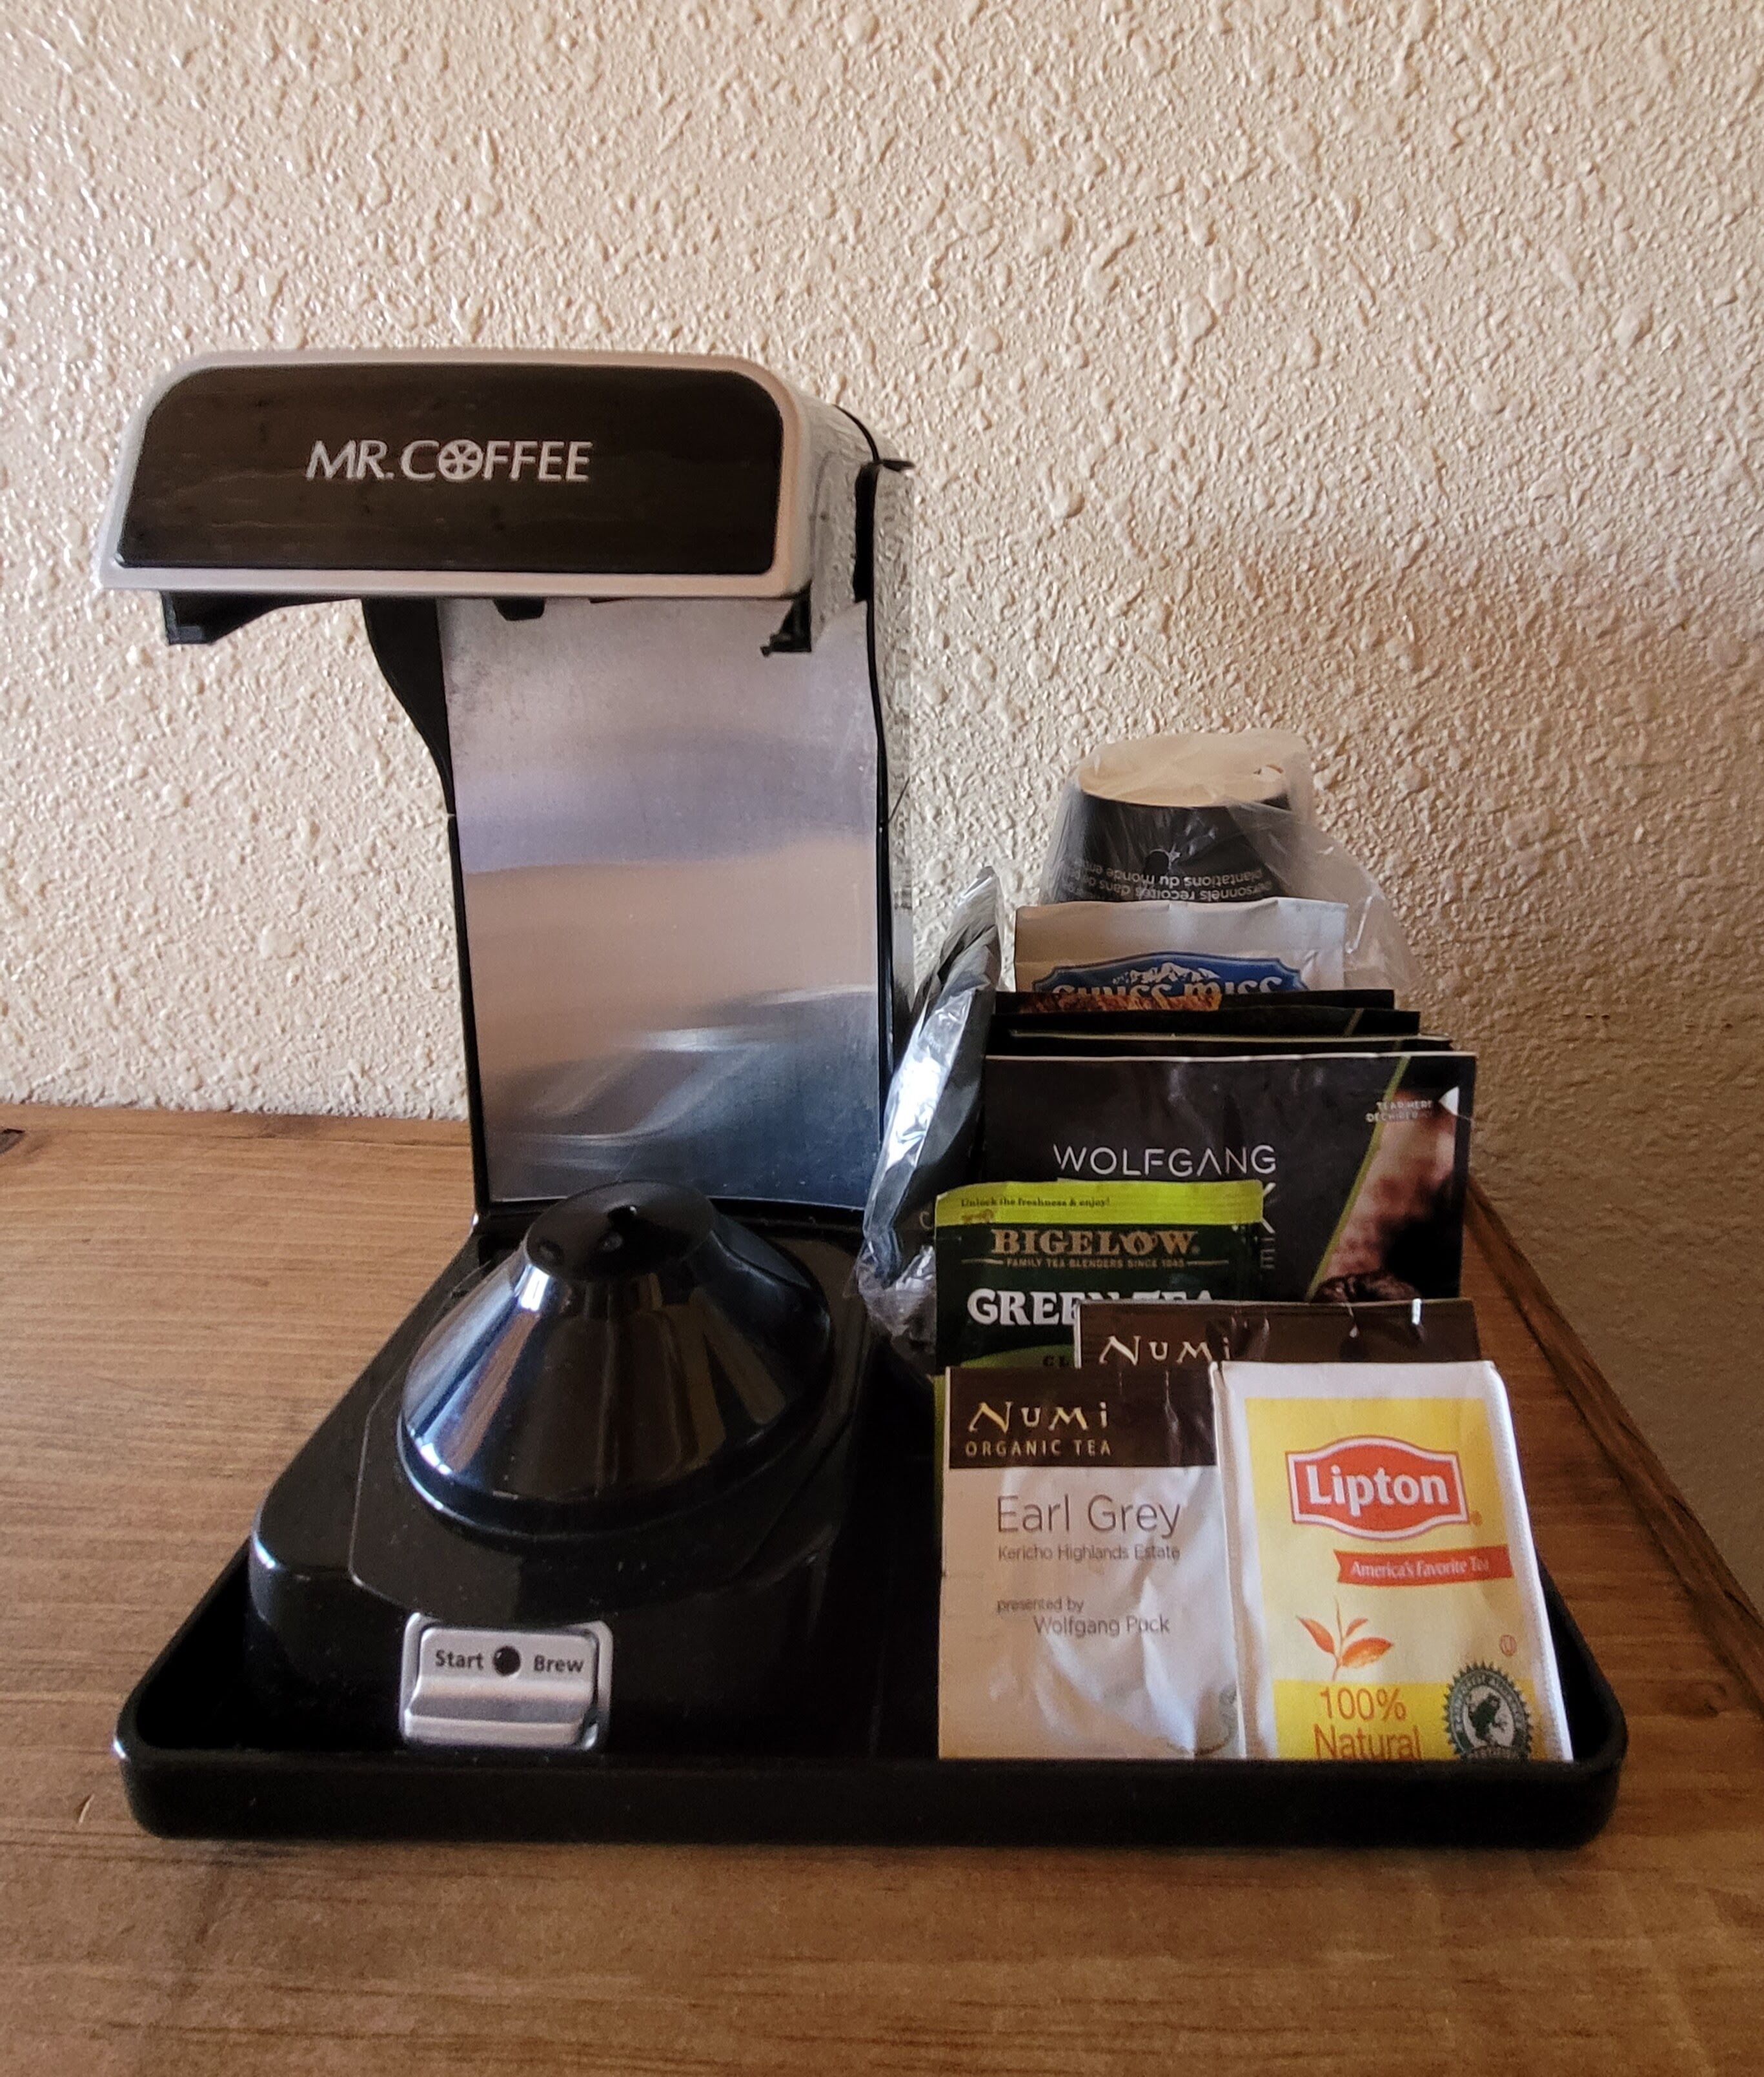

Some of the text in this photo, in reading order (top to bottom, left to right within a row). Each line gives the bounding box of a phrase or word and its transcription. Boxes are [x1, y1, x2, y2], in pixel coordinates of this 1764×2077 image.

[305, 439, 593, 481] MR. COFFEE
[1106, 868, 1155, 885] monde
[1161, 875, 1181, 887] du
[1053, 1144, 1277, 1177] WOLFGANG
[961, 1196, 1110, 1208] Unlock the freshness & enjoy!
[1006, 1258, 1042, 1268] FAMILY
[1046, 1258, 1066, 1268] TEA
[1068, 1258, 1124, 1269] BLENDERS
[1127, 1259, 1158, 1269] SINCE
[965, 1439, 1111, 1457] ORGANIC TEA
[1306, 1464, 1450, 1517] Lipton
[997, 1494, 1181, 1539] Earl Grey
[998, 1543, 1181, 1563] Kericho Highlands Estate
[1351, 1560, 1415, 1579] America's
[1415, 1559, 1468, 1577] Favorite
[997, 1596, 1084, 1614] presented by
[1033, 1614, 1171, 1637] Wolfgang Puck
[434, 1649, 585, 1674] Start Brew
[1319, 1685, 1408, 1722] 100%
[1313, 1723, 1422, 1759] Natural
